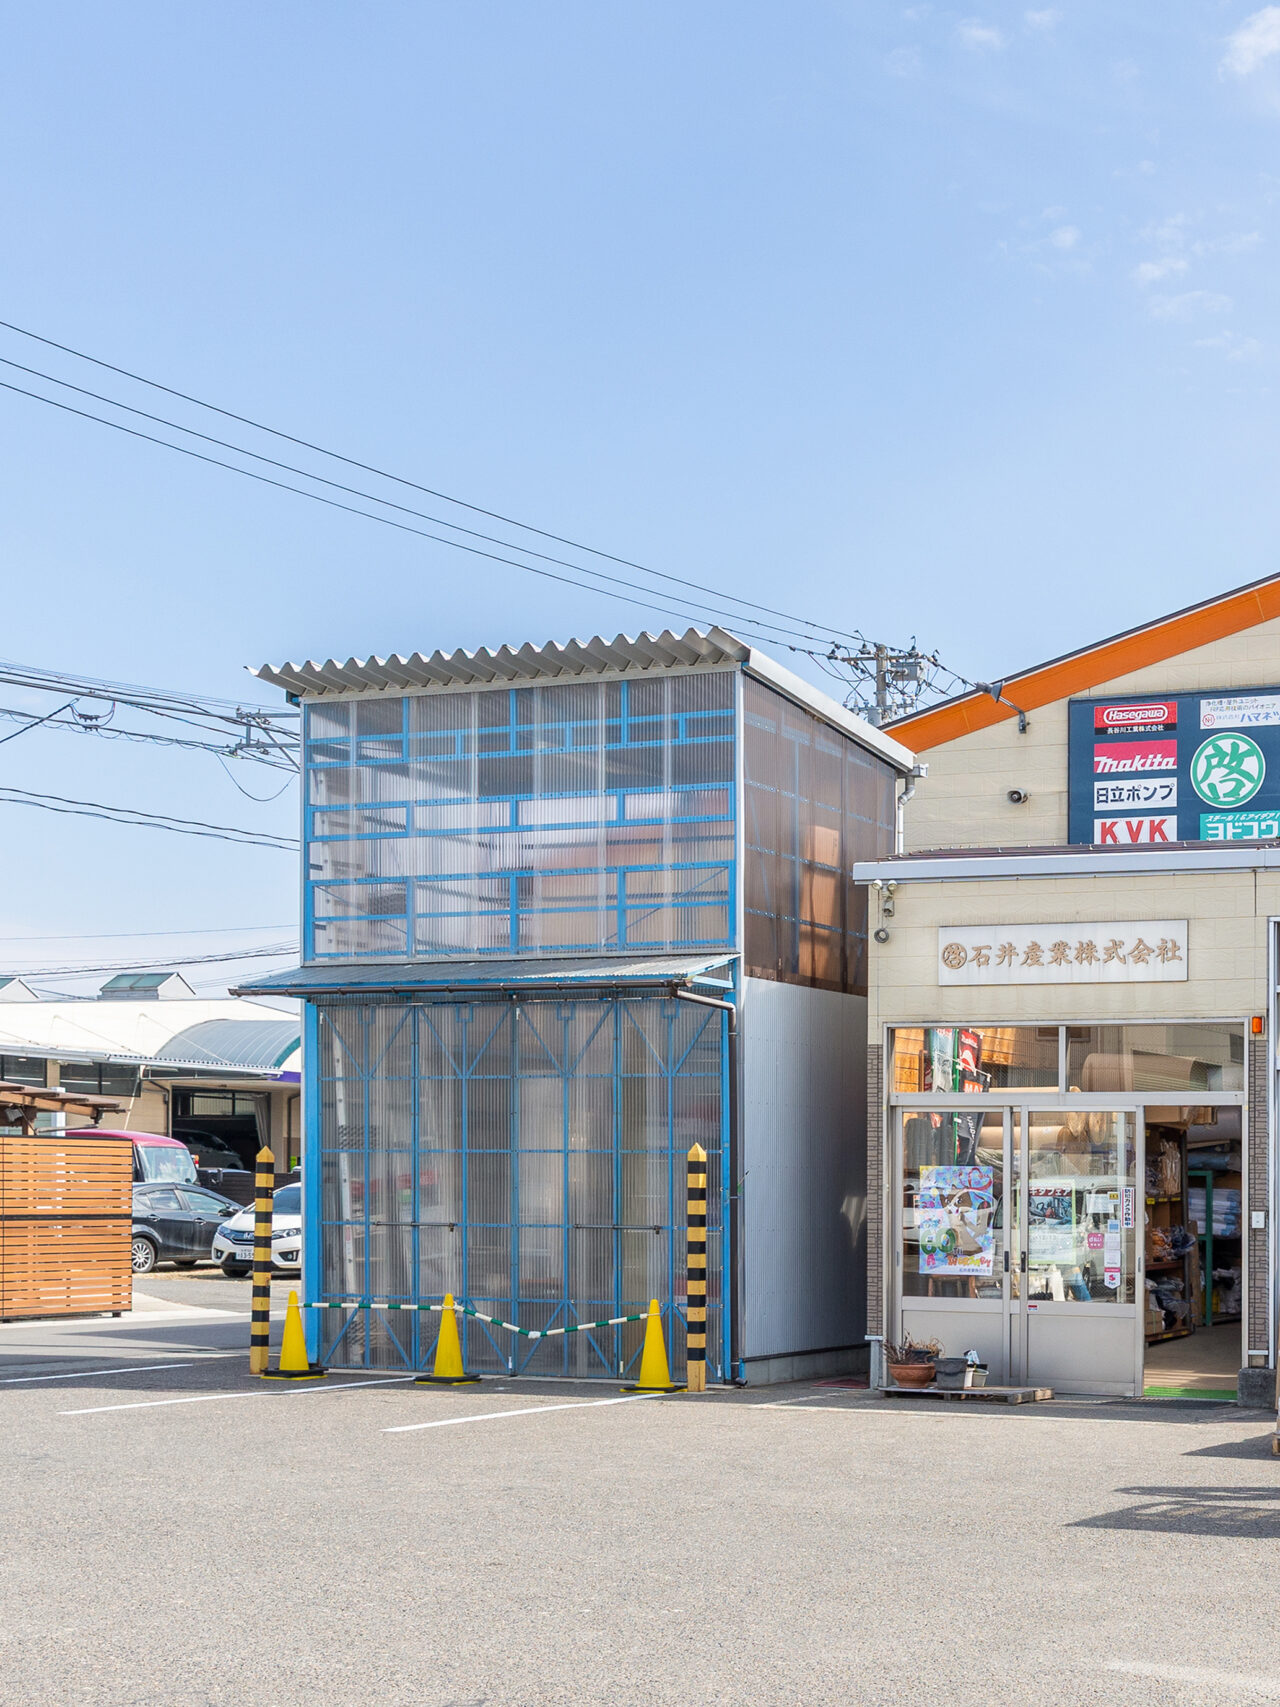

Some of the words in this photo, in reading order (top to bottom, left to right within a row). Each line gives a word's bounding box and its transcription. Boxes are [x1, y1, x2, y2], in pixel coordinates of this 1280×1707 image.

[1108, 709, 1164, 721] Hasegawa
[1096, 782, 1175, 805] 日立ポンプ
[1101, 819, 1168, 844] KVK
[1206, 820, 1279, 841] ヨドコウ
[968, 937, 1183, 968] 石井産業株式会社
[1029, 1187, 1072, 1196] キタフェア
